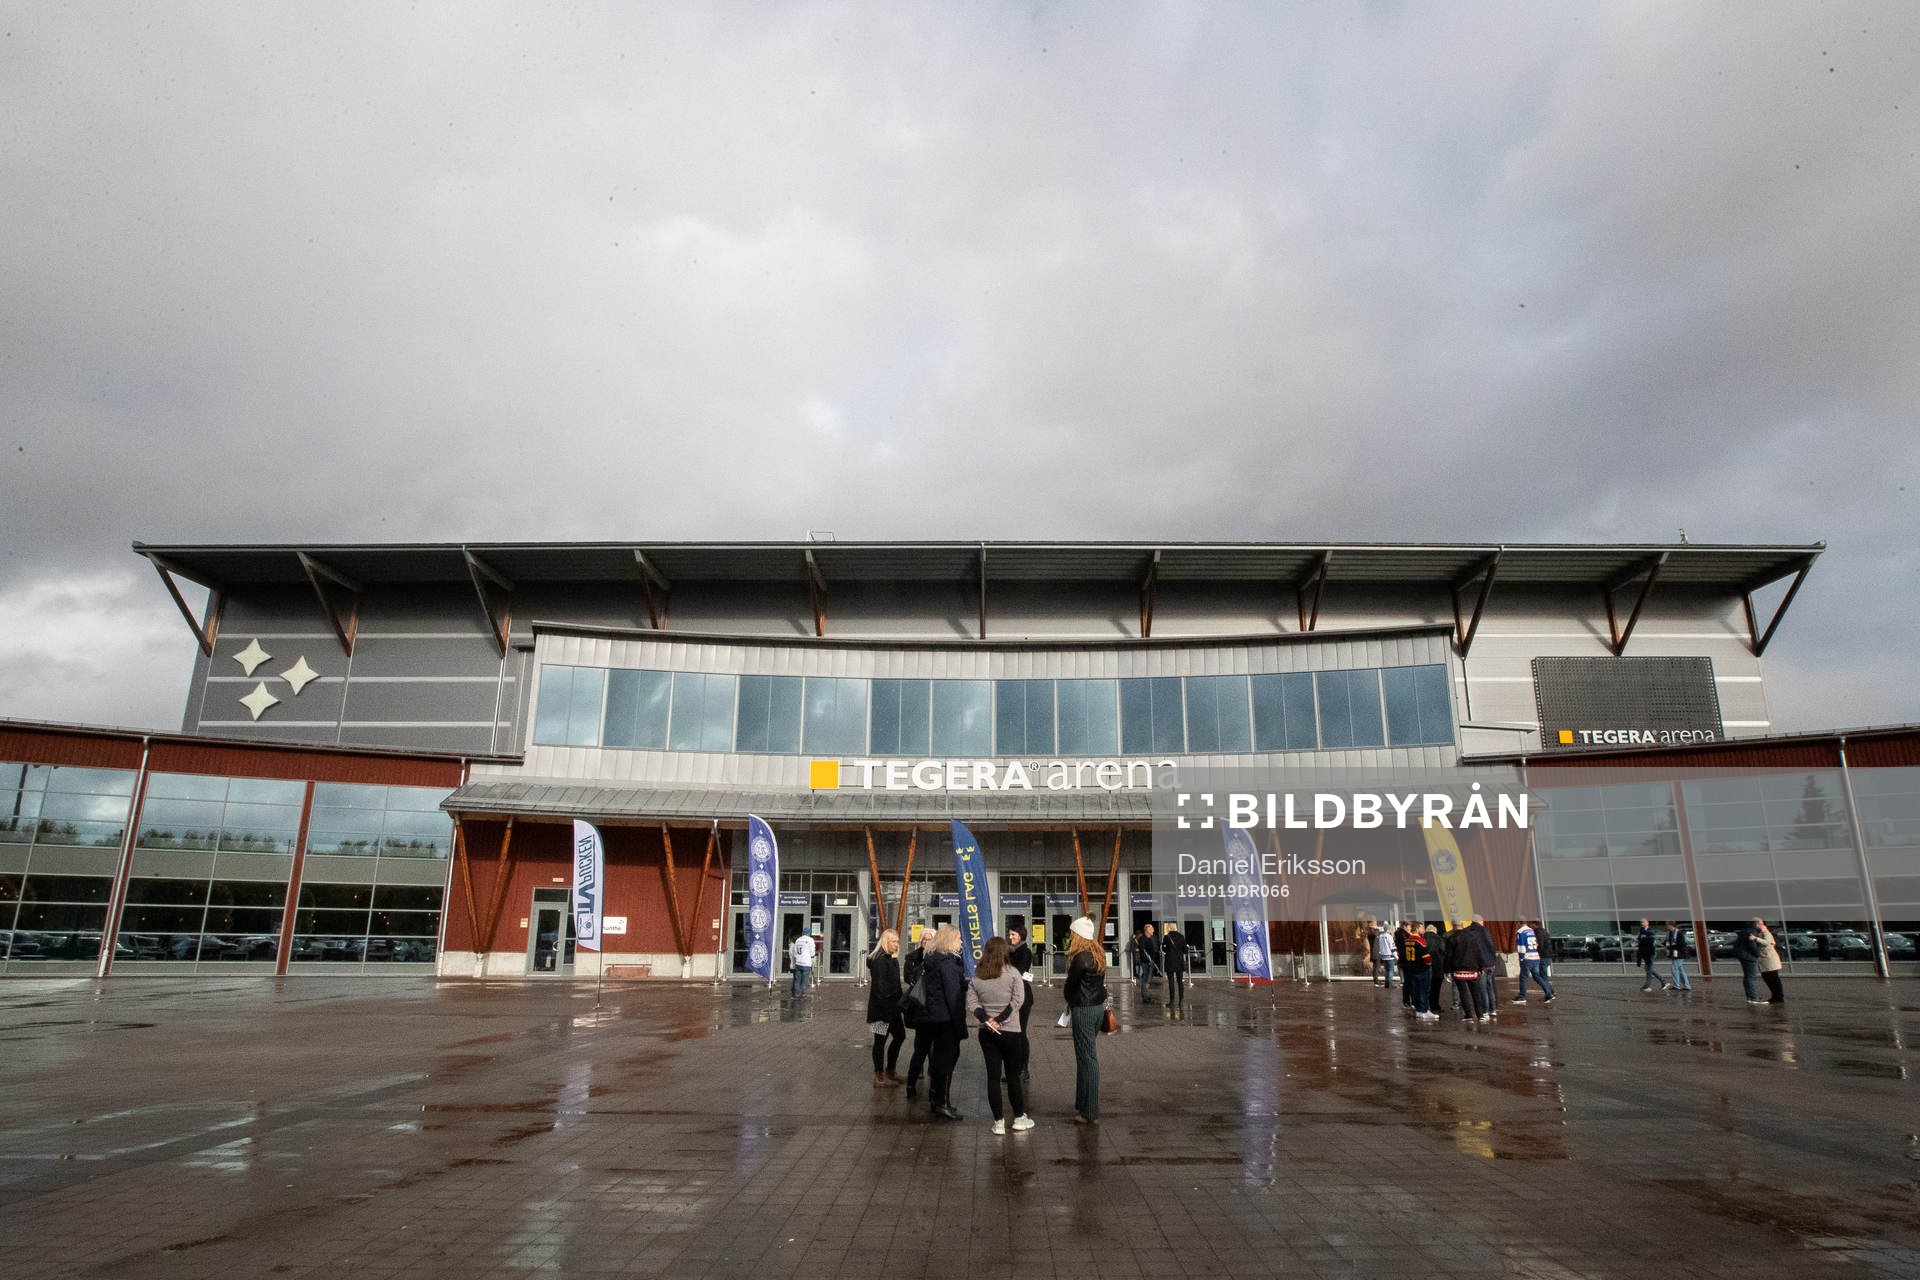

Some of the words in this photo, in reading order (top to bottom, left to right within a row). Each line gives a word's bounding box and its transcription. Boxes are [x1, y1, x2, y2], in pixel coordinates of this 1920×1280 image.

[1578, 730, 1656, 744] TEGERA
[1660, 729, 1715, 744] arena
[1046, 759, 1183, 791] arena
